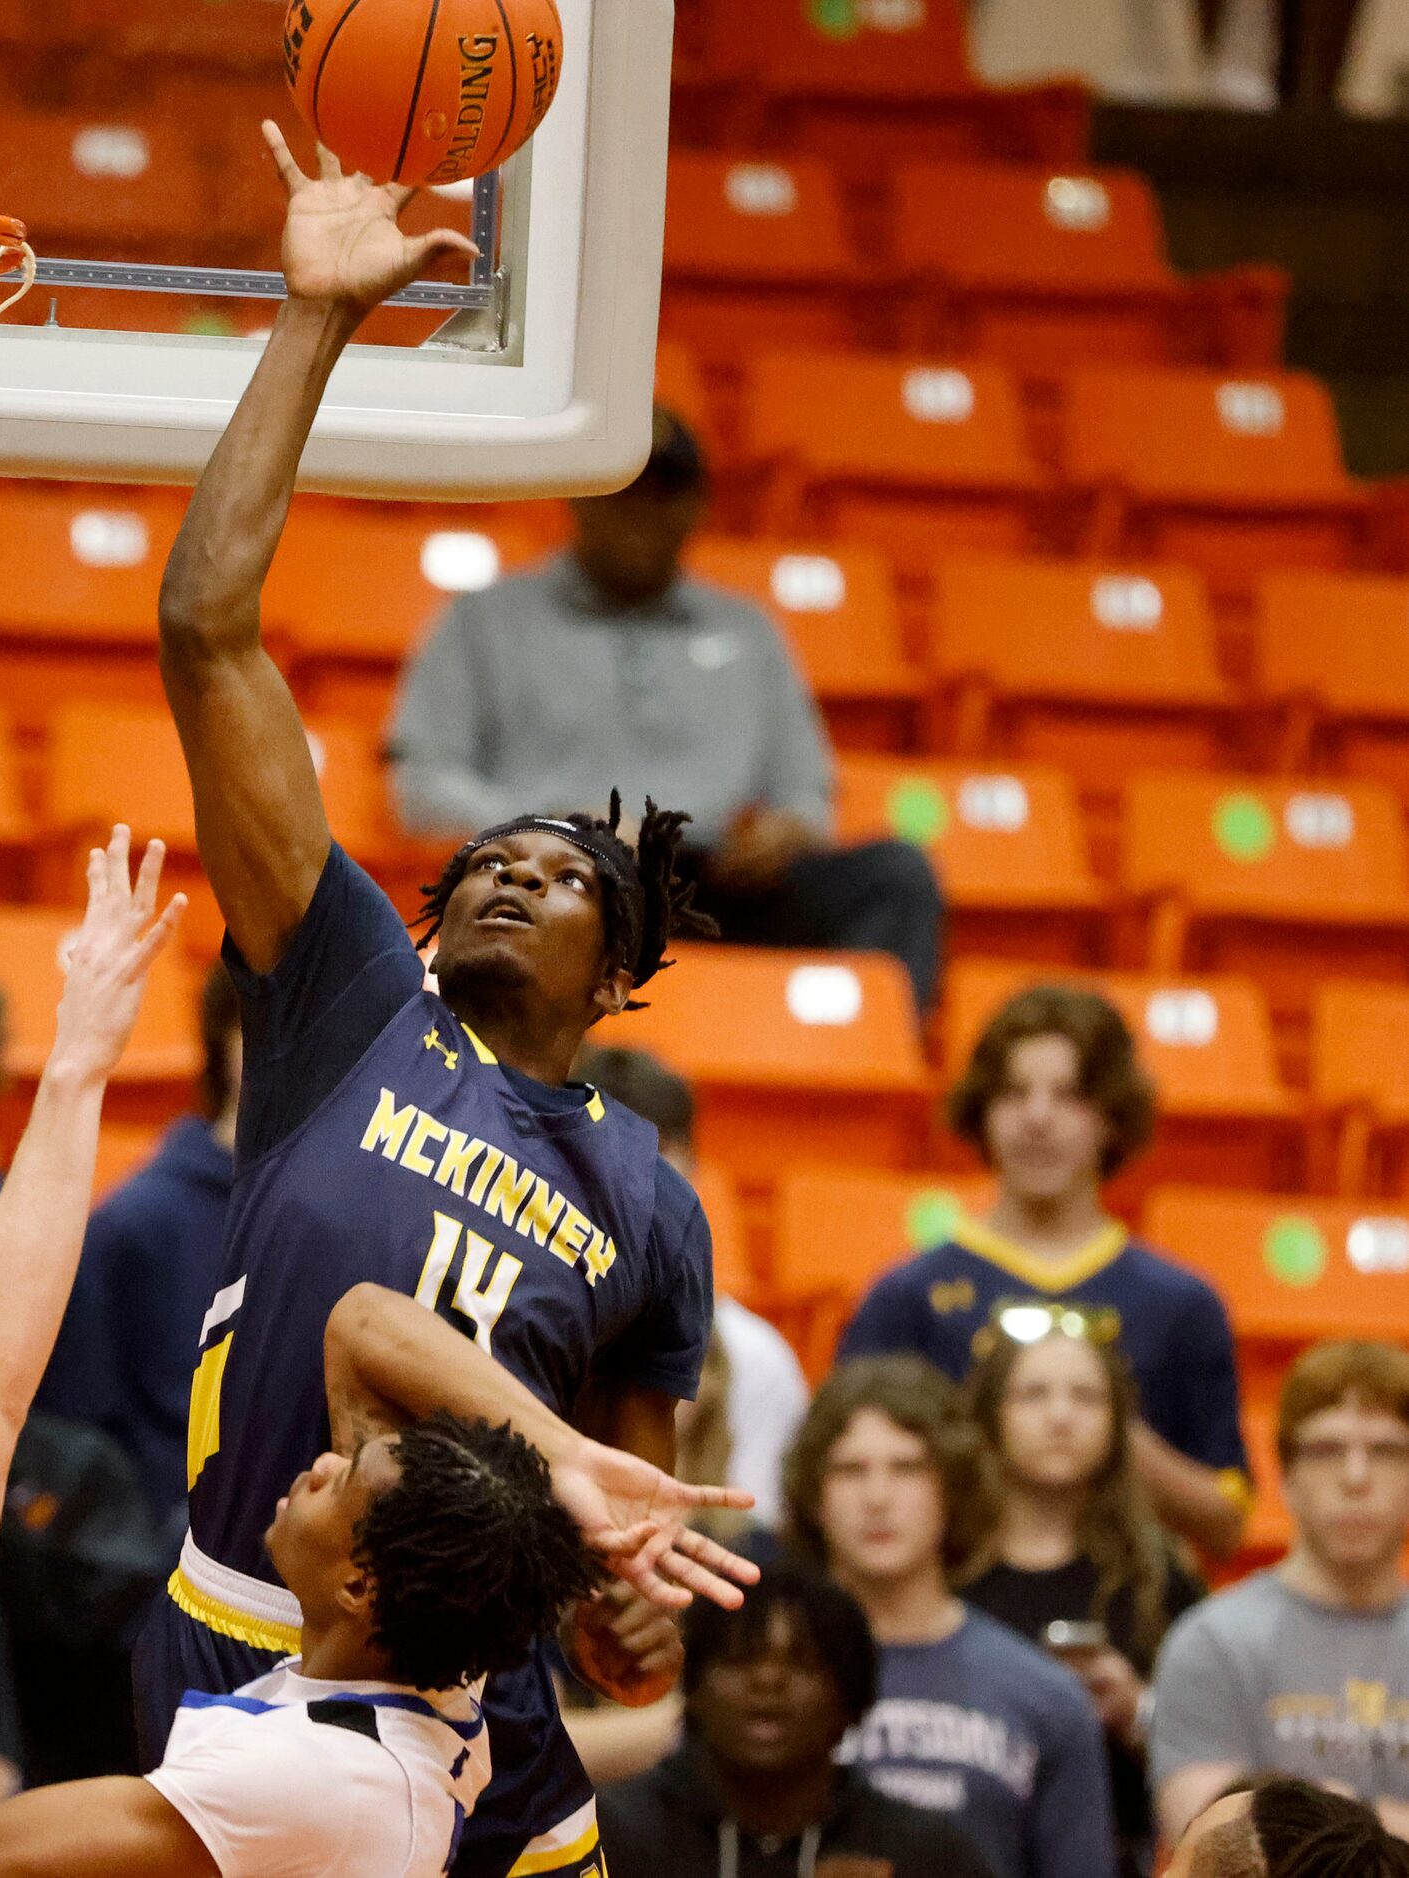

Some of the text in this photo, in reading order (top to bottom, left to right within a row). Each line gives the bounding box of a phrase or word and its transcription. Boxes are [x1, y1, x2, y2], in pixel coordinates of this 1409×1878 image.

[425, 34, 499, 184] SPALDING
[359, 1086, 618, 1288] MCKINNEY
[413, 1209, 524, 1356] 14
